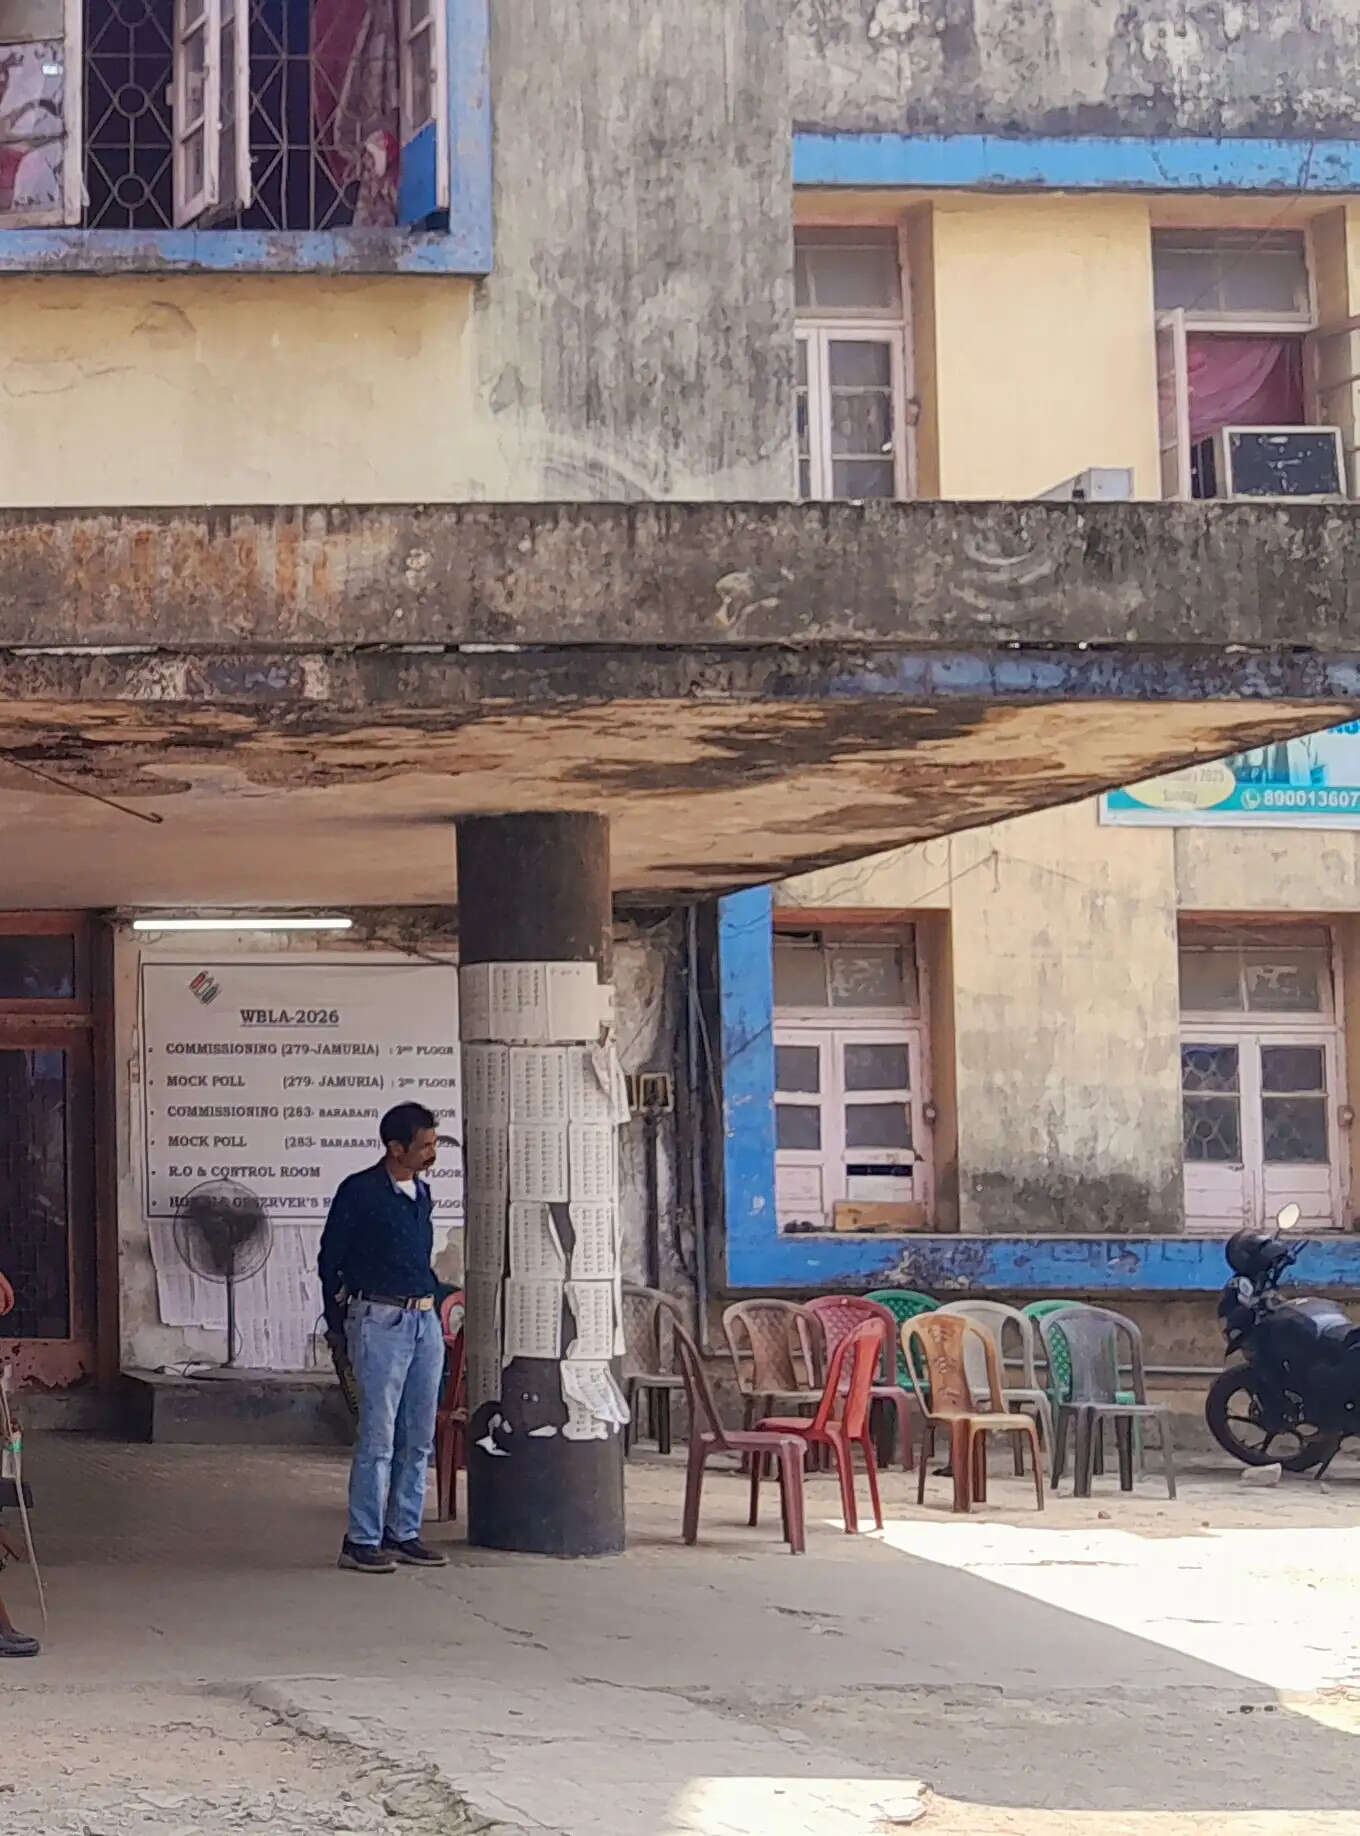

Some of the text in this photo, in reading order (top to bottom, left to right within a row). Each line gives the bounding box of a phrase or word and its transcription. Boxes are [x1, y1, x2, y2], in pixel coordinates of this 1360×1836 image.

[240, 1009, 340, 1024] WBLA-2026
[166, 1043, 278, 1055] COMMISSIONING
[416, 1046, 453, 1055] FLOOR
[167, 1075, 208, 1087] MOCK
[212, 1075, 246, 1088] POLL
[319, 1075, 384, 1090] JAMURIA)
[419, 1078, 456, 1088] FLOOR
[167, 1106, 279, 1118] COMMISSIONING
[168, 1135, 209, 1147] MOCK
[213, 1135, 247, 1147] POLL
[211, 1166, 276, 1177] CONTROL
[280, 1166, 320, 1177] ROOM
